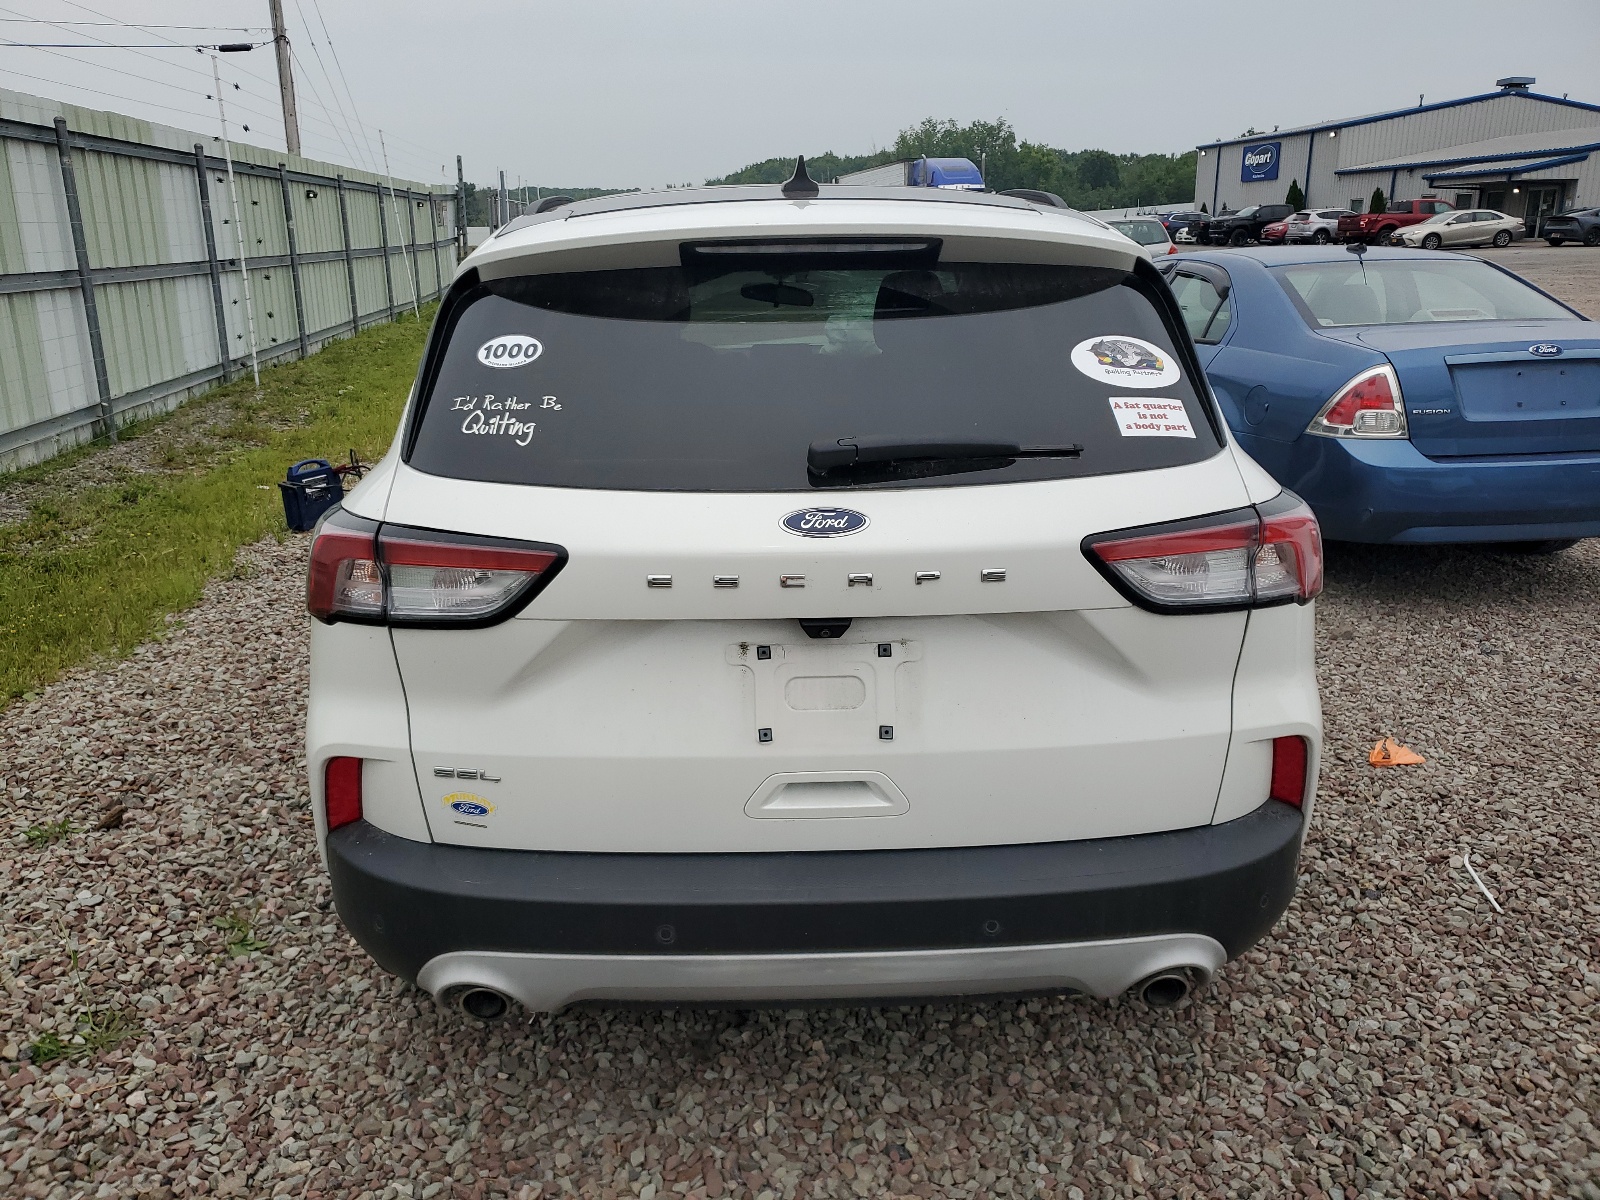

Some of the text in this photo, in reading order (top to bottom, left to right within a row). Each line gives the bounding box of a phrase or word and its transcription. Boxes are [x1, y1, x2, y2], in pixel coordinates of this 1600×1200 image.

[1245, 151, 1271, 167] Copart
[484, 343, 539, 360] 1000
[450, 394, 563, 411] I'd Rather Be
[1142, 403, 1183, 411] quarter
[1137, 412, 1169, 420] is not
[461, 409, 537, 447] Quilting
[1133, 422, 1162, 432] body
[1163, 424, 1187, 432] part
[800, 512, 849, 529] Ford
[646, 568, 1007, 590] ESCAPE
